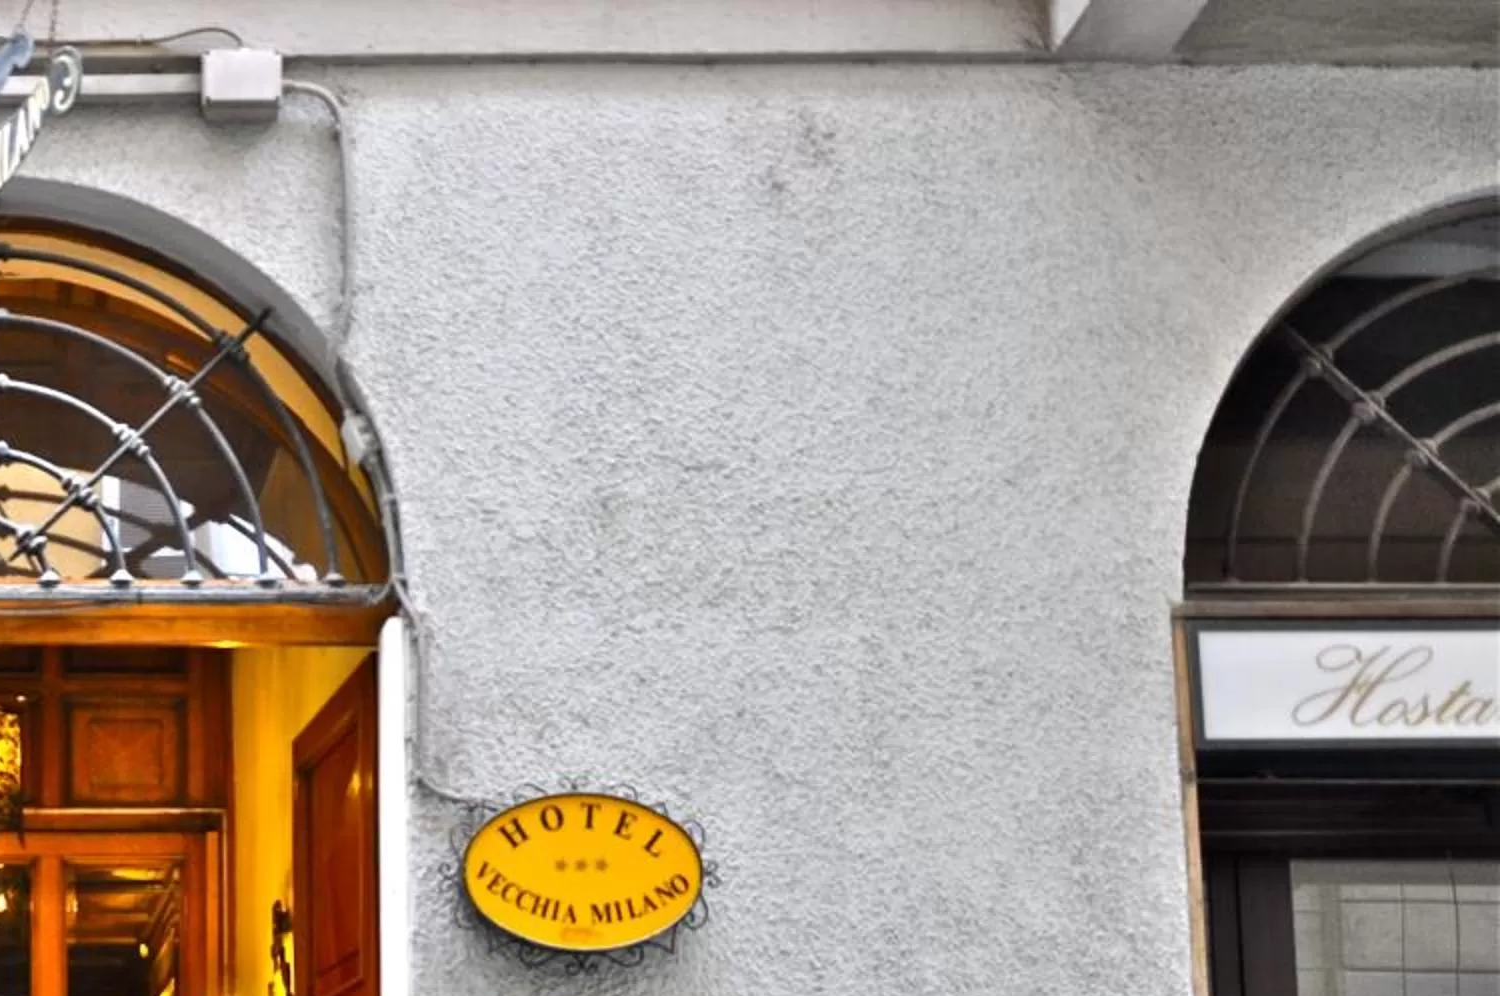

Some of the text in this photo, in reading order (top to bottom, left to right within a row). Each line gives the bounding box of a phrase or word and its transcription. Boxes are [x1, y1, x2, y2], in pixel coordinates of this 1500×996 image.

[497, 802, 665, 858] HOTEL
[476, 861, 690, 925] VECCHIA MILANO
